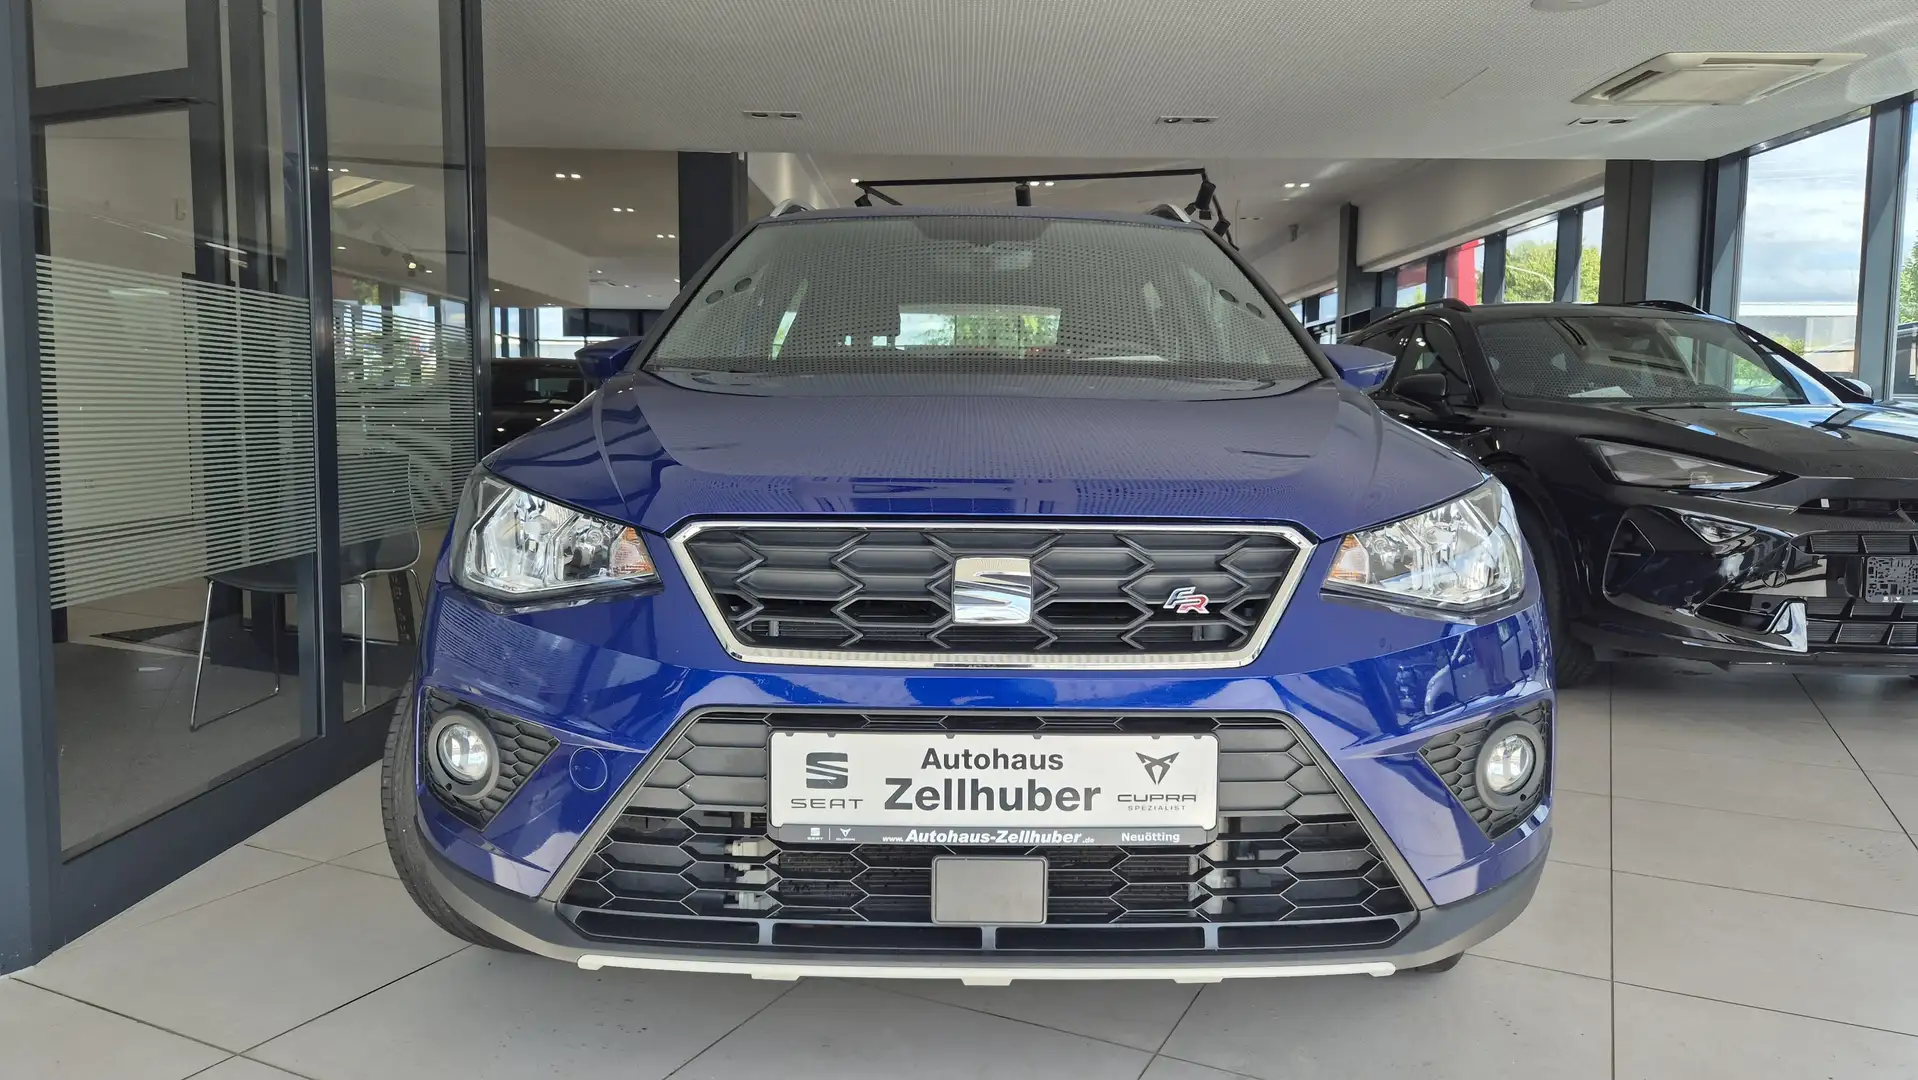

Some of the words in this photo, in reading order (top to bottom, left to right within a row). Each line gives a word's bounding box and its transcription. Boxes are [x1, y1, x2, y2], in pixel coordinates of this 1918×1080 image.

[1163, 586, 1210, 614] FR
[920, 747, 1064, 771] Autohaus
[884, 777, 1101, 812] Zellhuber
[1117, 793, 1197, 803] CUPRA
[790, 798, 864, 809] SEAT
[882, 829, 1095, 844] www.Autohaus-Zellhuber.de
[1121, 832, 1180, 843] Neuötting
